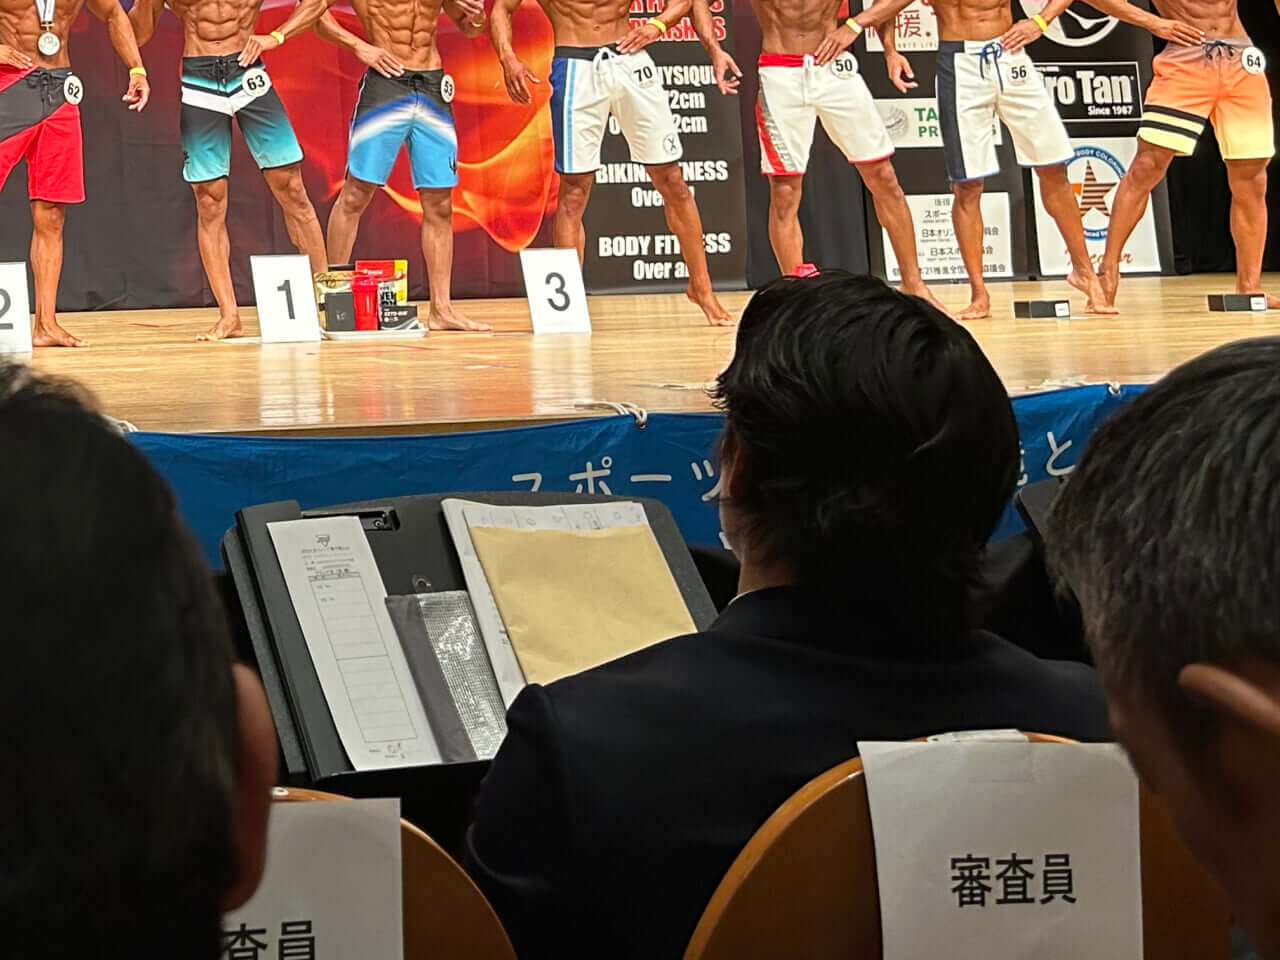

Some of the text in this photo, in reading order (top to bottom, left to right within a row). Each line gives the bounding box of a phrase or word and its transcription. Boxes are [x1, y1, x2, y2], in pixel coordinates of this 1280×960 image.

[834, 58, 853, 74] 50
[1011, 65, 1027, 79] 56
[1246, 54, 1262, 70] 64
[247, 74, 266, 91] 63
[634, 66, 652, 82] 70
[656, 65, 717, 87] YSIQU
[67, 83, 80, 99] 62
[444, 81, 453, 96] 53
[1044, 71, 1133, 105] ro Tan
[664, 89, 706, 109] 2cm
[1087, 105, 1110, 115] Since
[672, 113, 709, 133] 2cm
[595, 161, 728, 183] BIKIN NESS
[631, 187, 665, 207] Ove
[925, 210, 952, 218] スポー
[598, 235, 651, 256] BODY
[633, 260, 672, 280] Over
[277, 279, 296, 320] 1
[545, 272, 571, 312] 3
[950, 853, 1077, 908] 審査員
[222, 920, 316, 960] 査員
